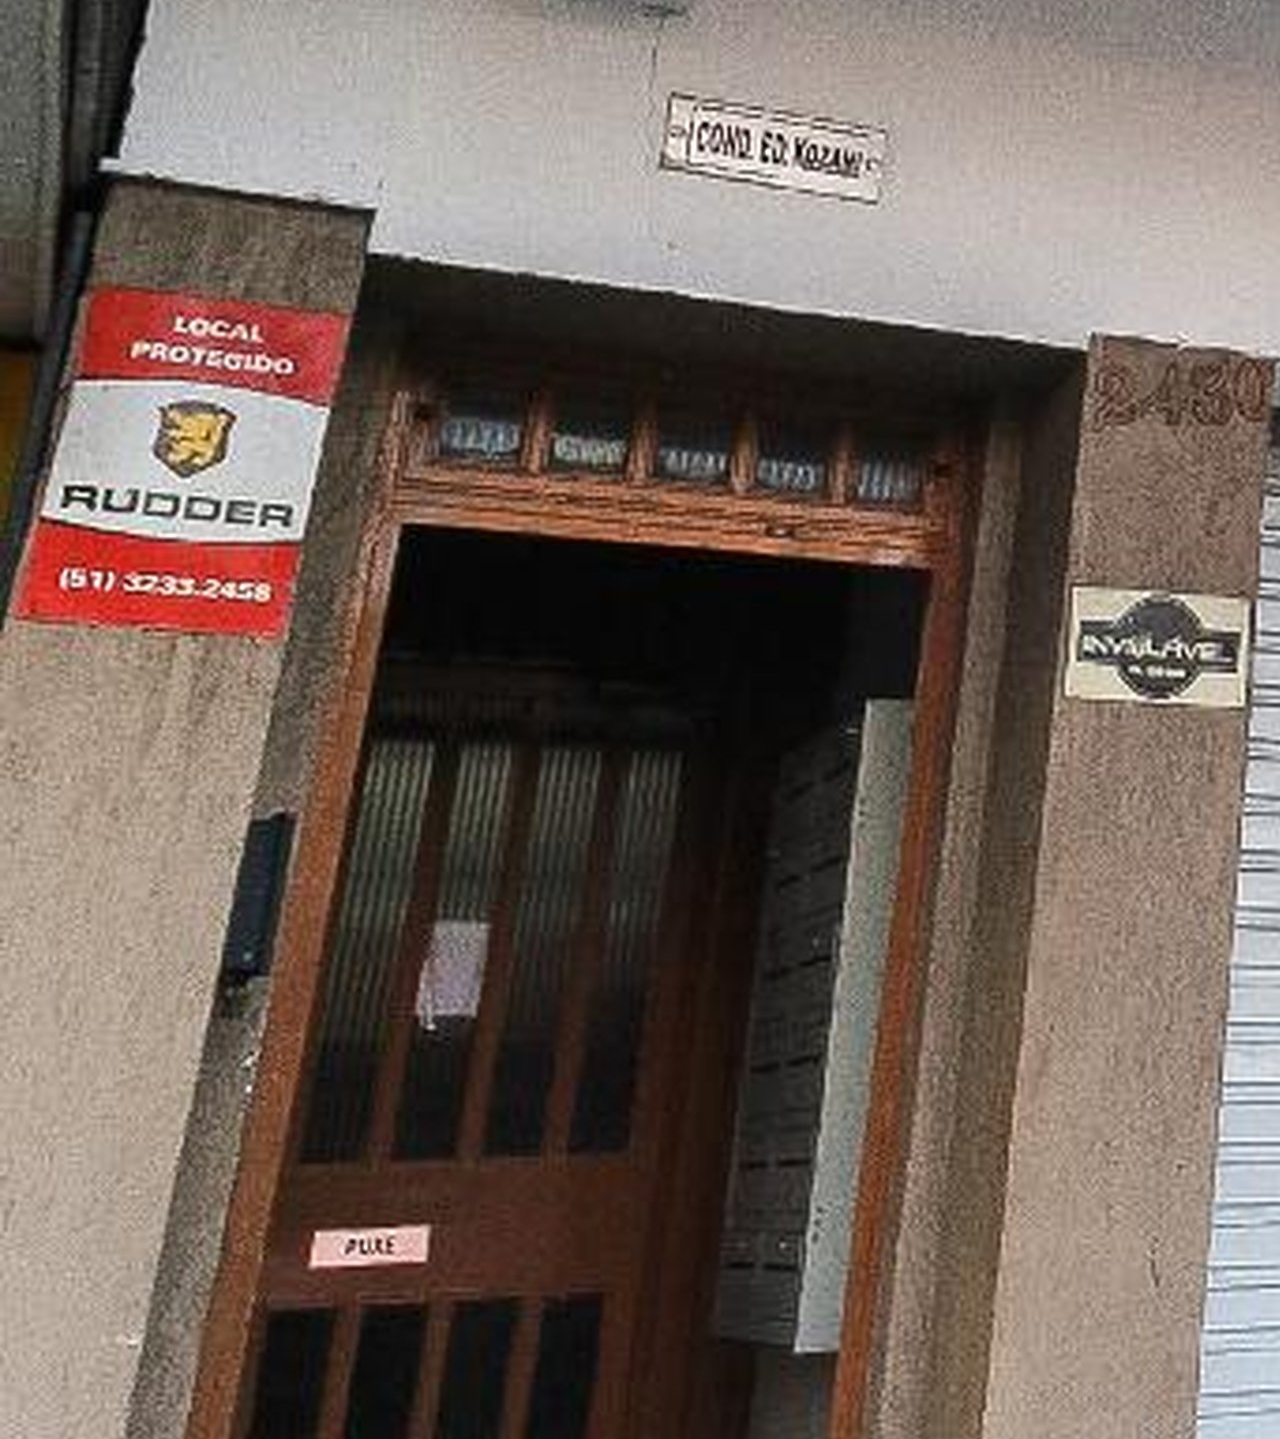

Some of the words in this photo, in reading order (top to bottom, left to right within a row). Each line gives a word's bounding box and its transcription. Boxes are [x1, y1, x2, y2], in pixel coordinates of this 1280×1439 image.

[174, 315, 264, 343] LOCAL
[130, 341, 295, 376] PROTEGIDO
[60, 484, 295, 528] RUDDER
[59, 568, 114, 593] (51)
